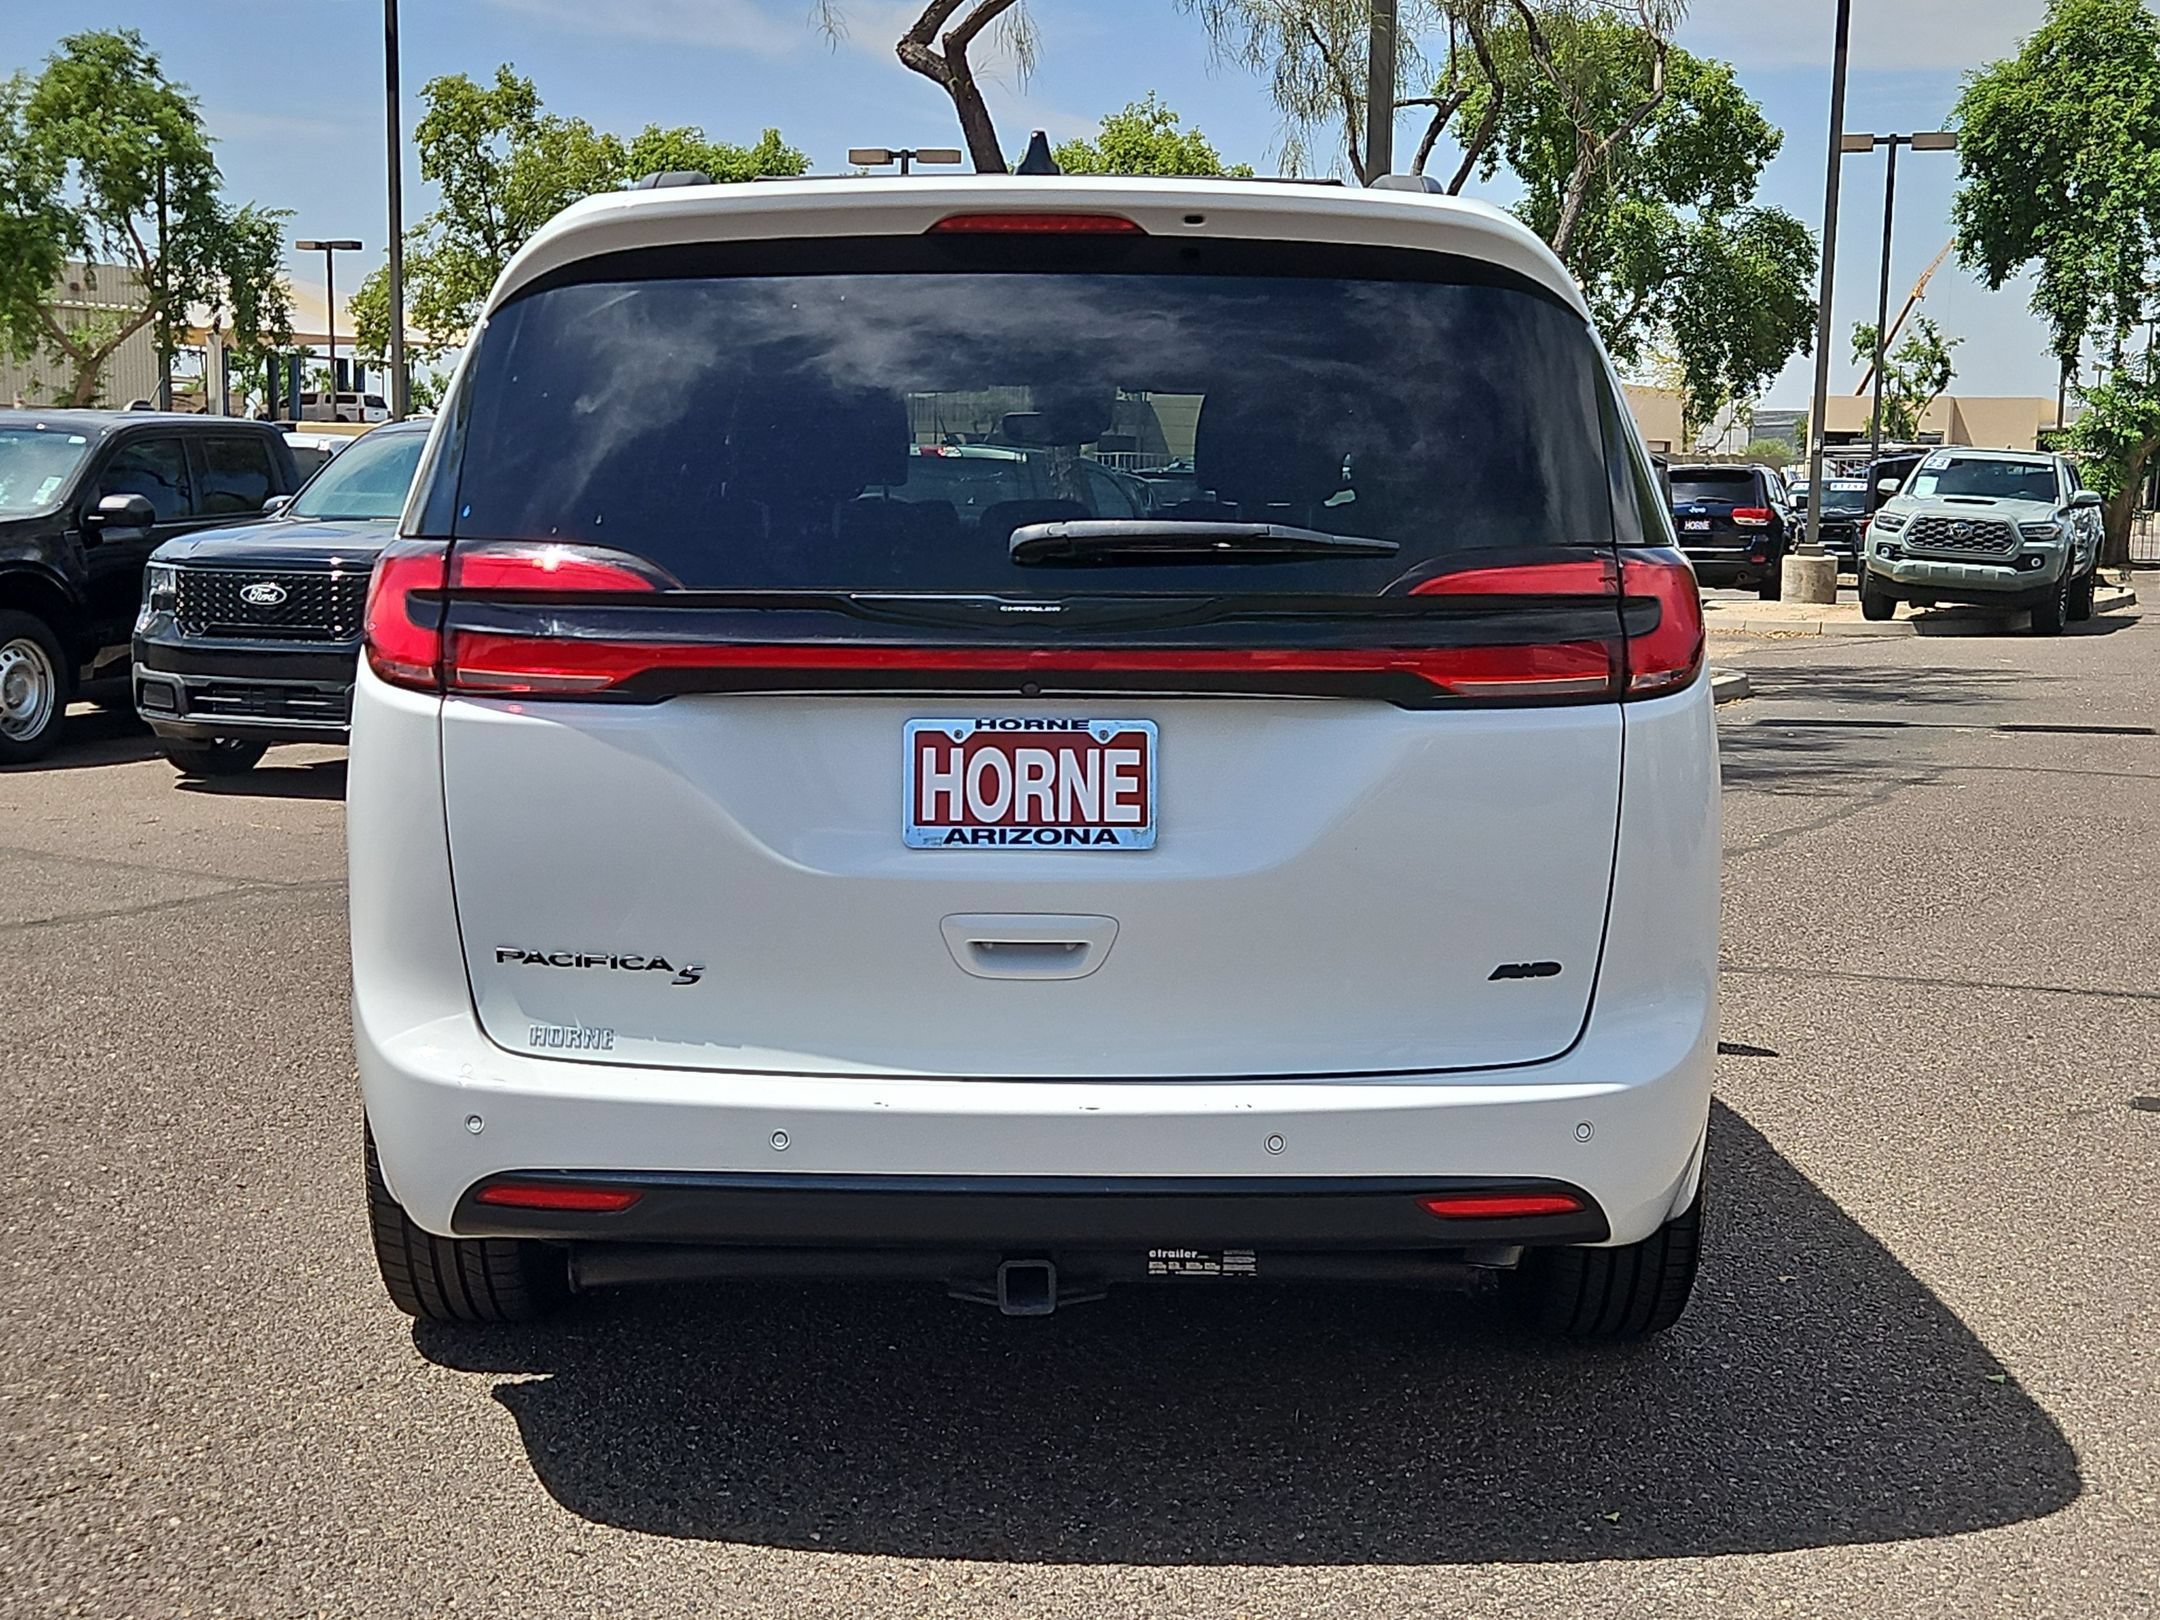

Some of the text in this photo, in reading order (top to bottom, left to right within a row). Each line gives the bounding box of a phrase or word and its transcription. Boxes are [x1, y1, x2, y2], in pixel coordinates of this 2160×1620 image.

[1927, 458, 1948, 467] 23
[1684, 520, 1710, 530] HORNE
[249, 587, 278, 601] Ford
[974, 719, 1089, 730] HORNE
[921, 746, 1141, 823] HORNE
[943, 828, 1120, 845] ARIZONA
[495, 946, 706, 986] PACIFICA S
[529, 1025, 614, 1050] HORNE
